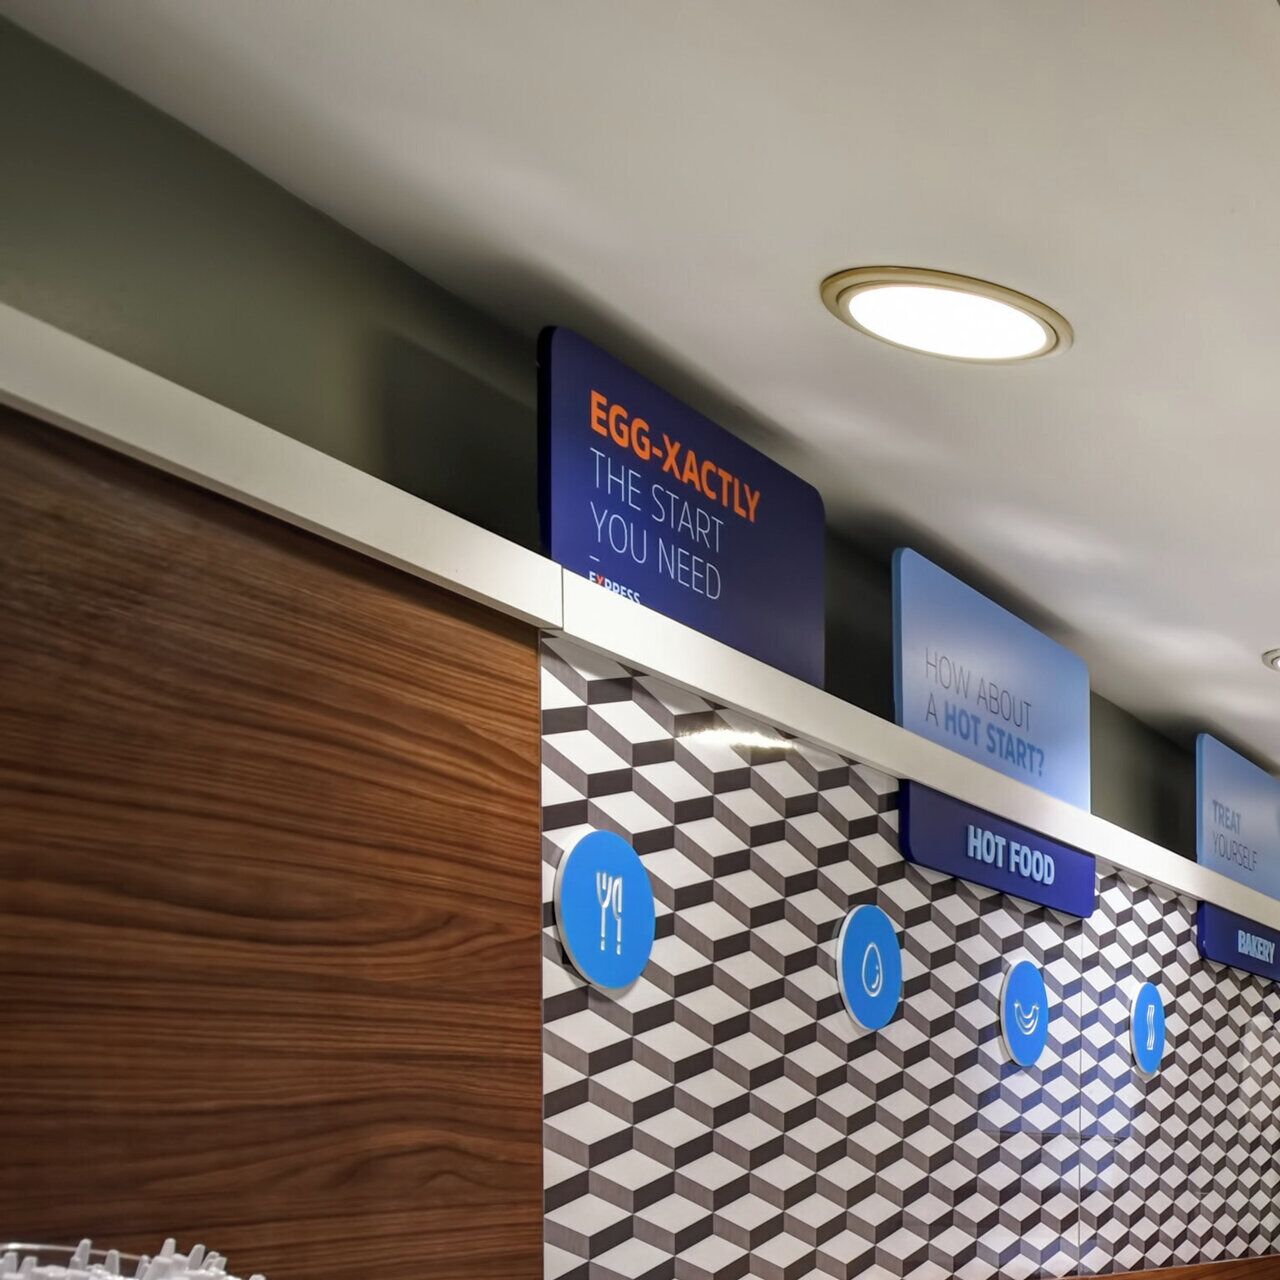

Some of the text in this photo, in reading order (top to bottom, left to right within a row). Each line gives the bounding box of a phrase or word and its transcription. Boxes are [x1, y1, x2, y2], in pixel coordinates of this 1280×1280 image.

[591, 390, 760, 523] EGG-XACTLY
[590, 447, 724, 553] THE START
[590, 501, 721, 600] YOU NEED
[925, 646, 1032, 733] HOW ABOUT
[925, 692, 1045, 777] A HOT START?
[967, 824, 1055, 886] HOT FOOD
[1212, 799, 1241, 836] TREAT
[1212, 831, 1258, 873] YOURSELF
[1237, 929, 1275, 964] BAKERY
